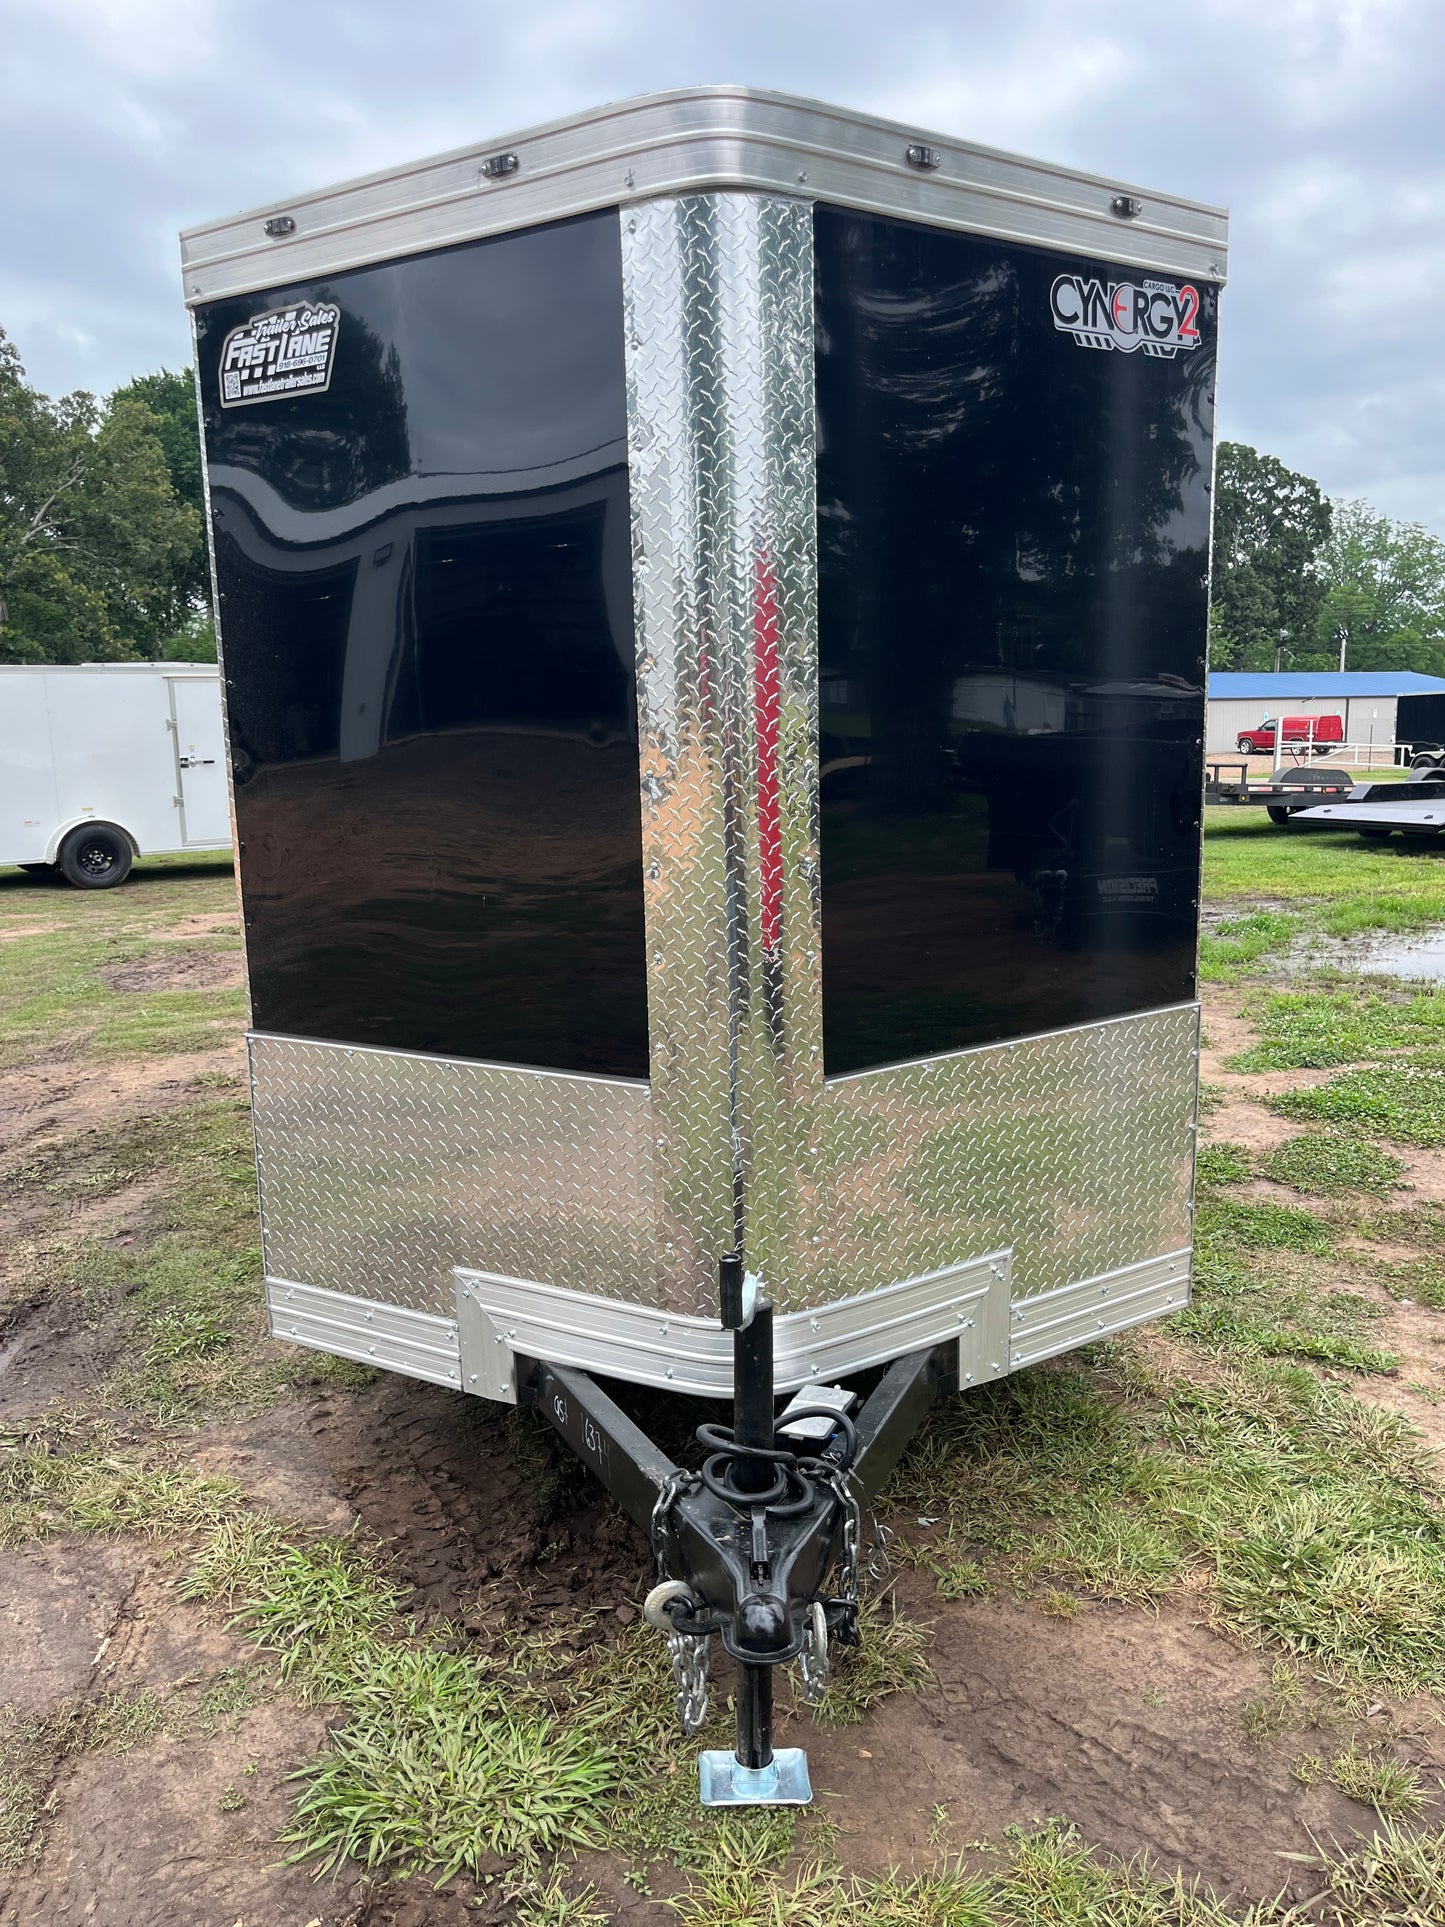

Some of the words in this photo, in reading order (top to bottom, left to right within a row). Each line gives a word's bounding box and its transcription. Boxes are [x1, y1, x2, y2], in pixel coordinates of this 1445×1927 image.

[1144, 282, 1164, 292] CARGO
[1165, 284, 1175, 293] LLC
[254, 318, 298, 340] Trailer
[299, 310, 336, 331] Sales
[225, 337, 280, 370] FAST
[277, 329, 332, 367] LANE
[278, 354, 326, 370] 918-696-0701
